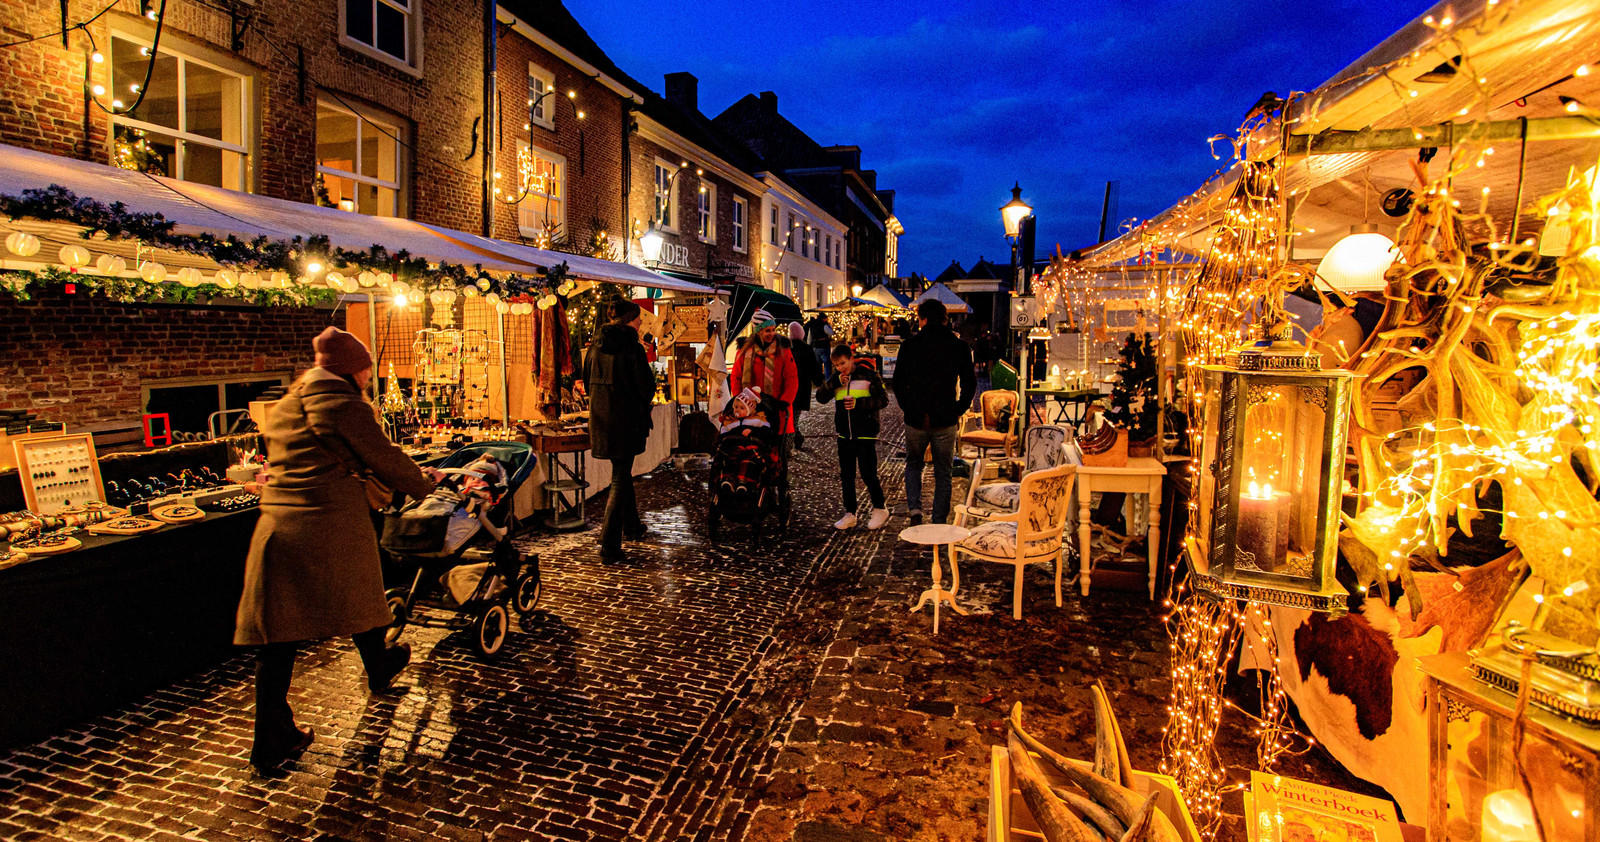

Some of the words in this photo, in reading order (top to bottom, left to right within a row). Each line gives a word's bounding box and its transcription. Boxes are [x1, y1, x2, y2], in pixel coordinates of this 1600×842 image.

[1261, 782, 1390, 822] Winterboek
[1283, 780, 1320, 794] Anton
[1324, 789, 1358, 803] Pieck
